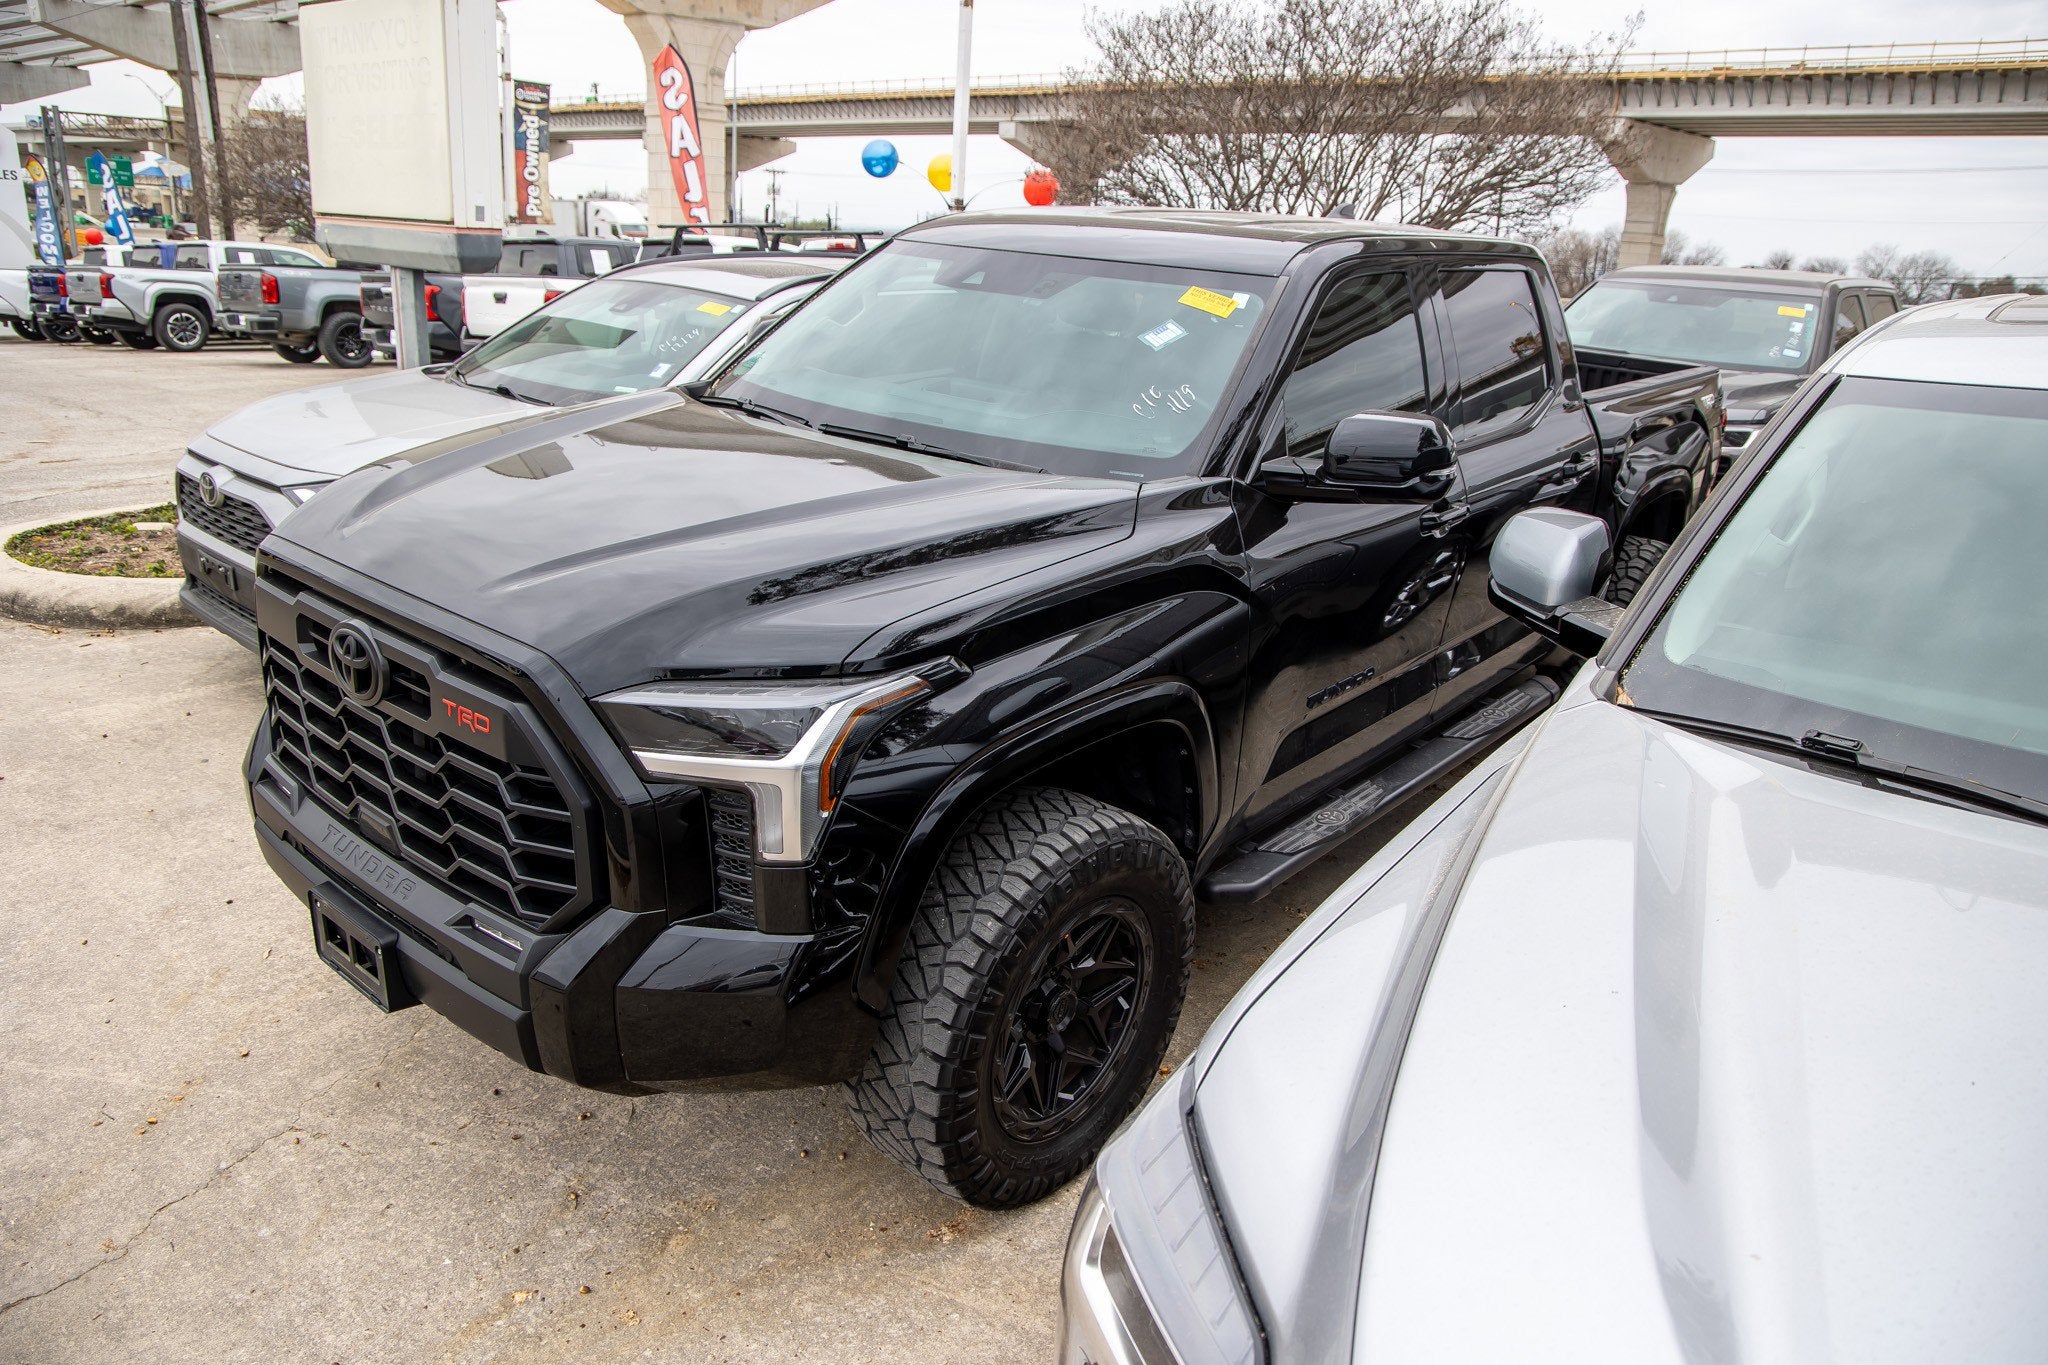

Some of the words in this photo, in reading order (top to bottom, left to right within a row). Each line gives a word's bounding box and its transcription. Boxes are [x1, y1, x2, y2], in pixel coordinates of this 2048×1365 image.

[316, 20, 379, 55] THANK
[379, 15, 424, 51] YOU
[352, 56, 432, 92] VISITING
[522, 114, 541, 183] Owned
[525, 184, 544, 217] Pre
[1305, 666, 1376, 709] TUNDRA
[441, 698, 491, 735] TRD
[319, 823, 418, 902] TUNDRA
